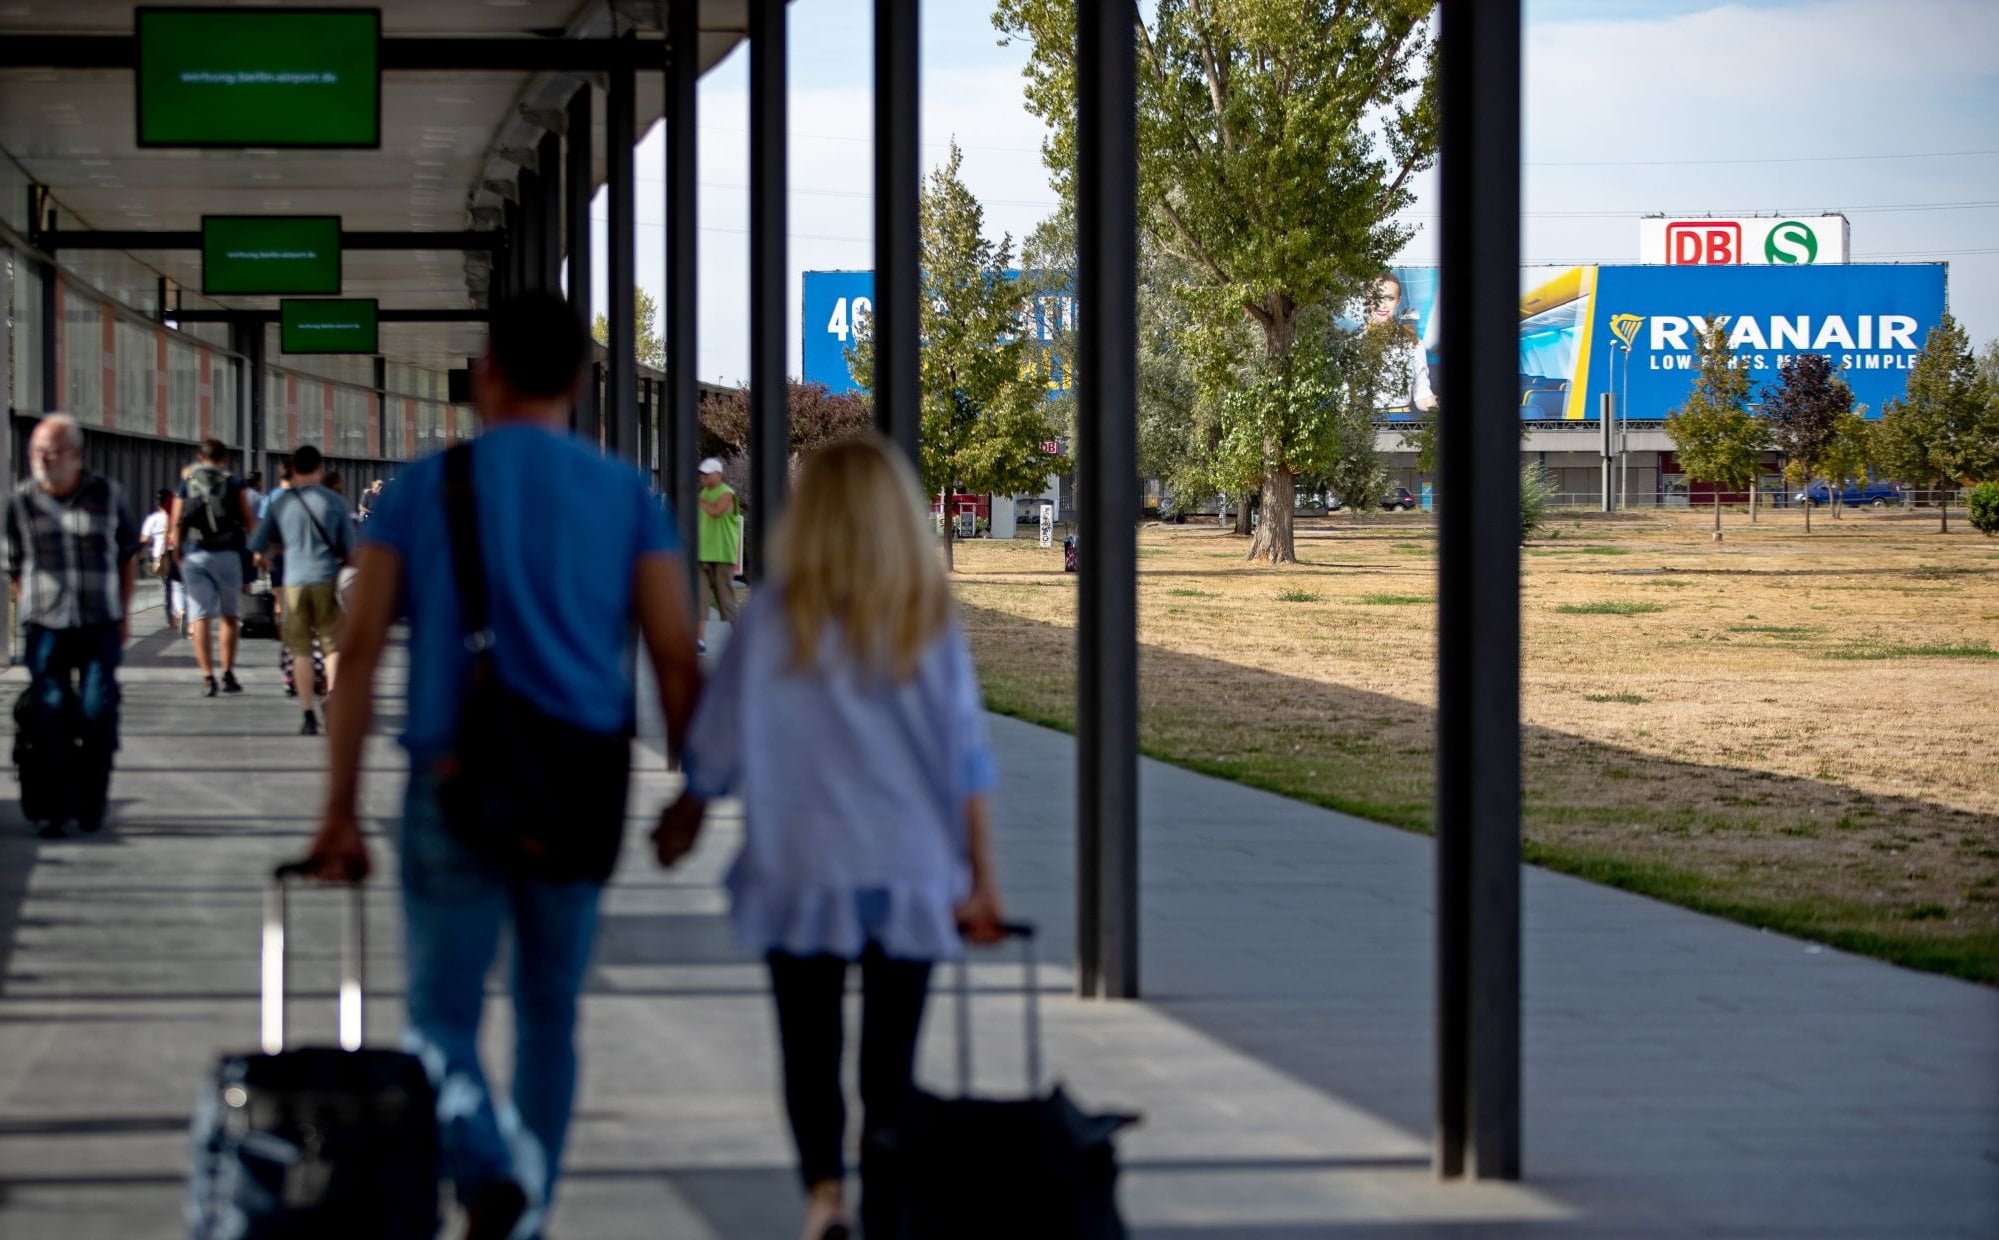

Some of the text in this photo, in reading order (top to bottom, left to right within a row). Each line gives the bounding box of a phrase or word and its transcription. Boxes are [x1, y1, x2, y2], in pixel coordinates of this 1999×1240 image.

[1676, 231, 1732, 265] DB
[1650, 315, 1919, 350] RYANAIR
[1650, 355, 1692, 370] LOW
